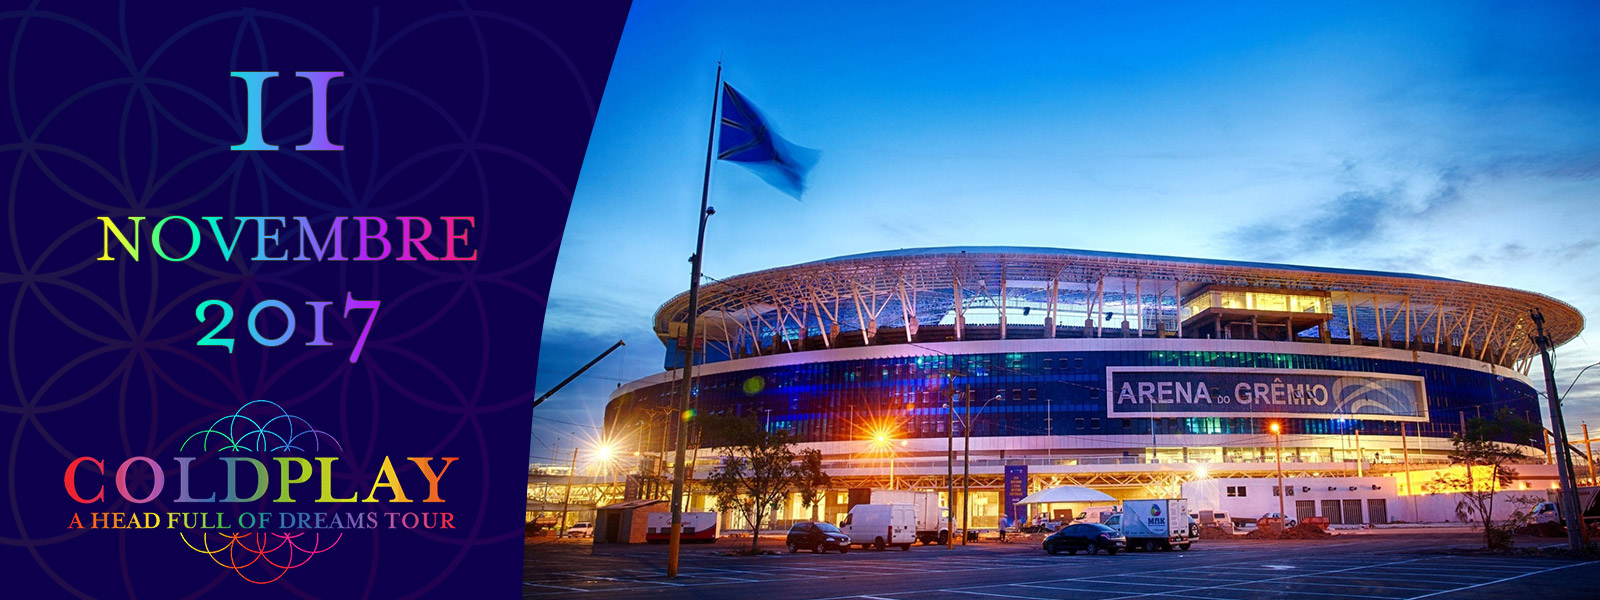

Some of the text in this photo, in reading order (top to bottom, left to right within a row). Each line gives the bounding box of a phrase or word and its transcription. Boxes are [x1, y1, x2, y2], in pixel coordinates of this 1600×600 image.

[1117, 378, 1329, 406] ARENA DO GRÊMIO
